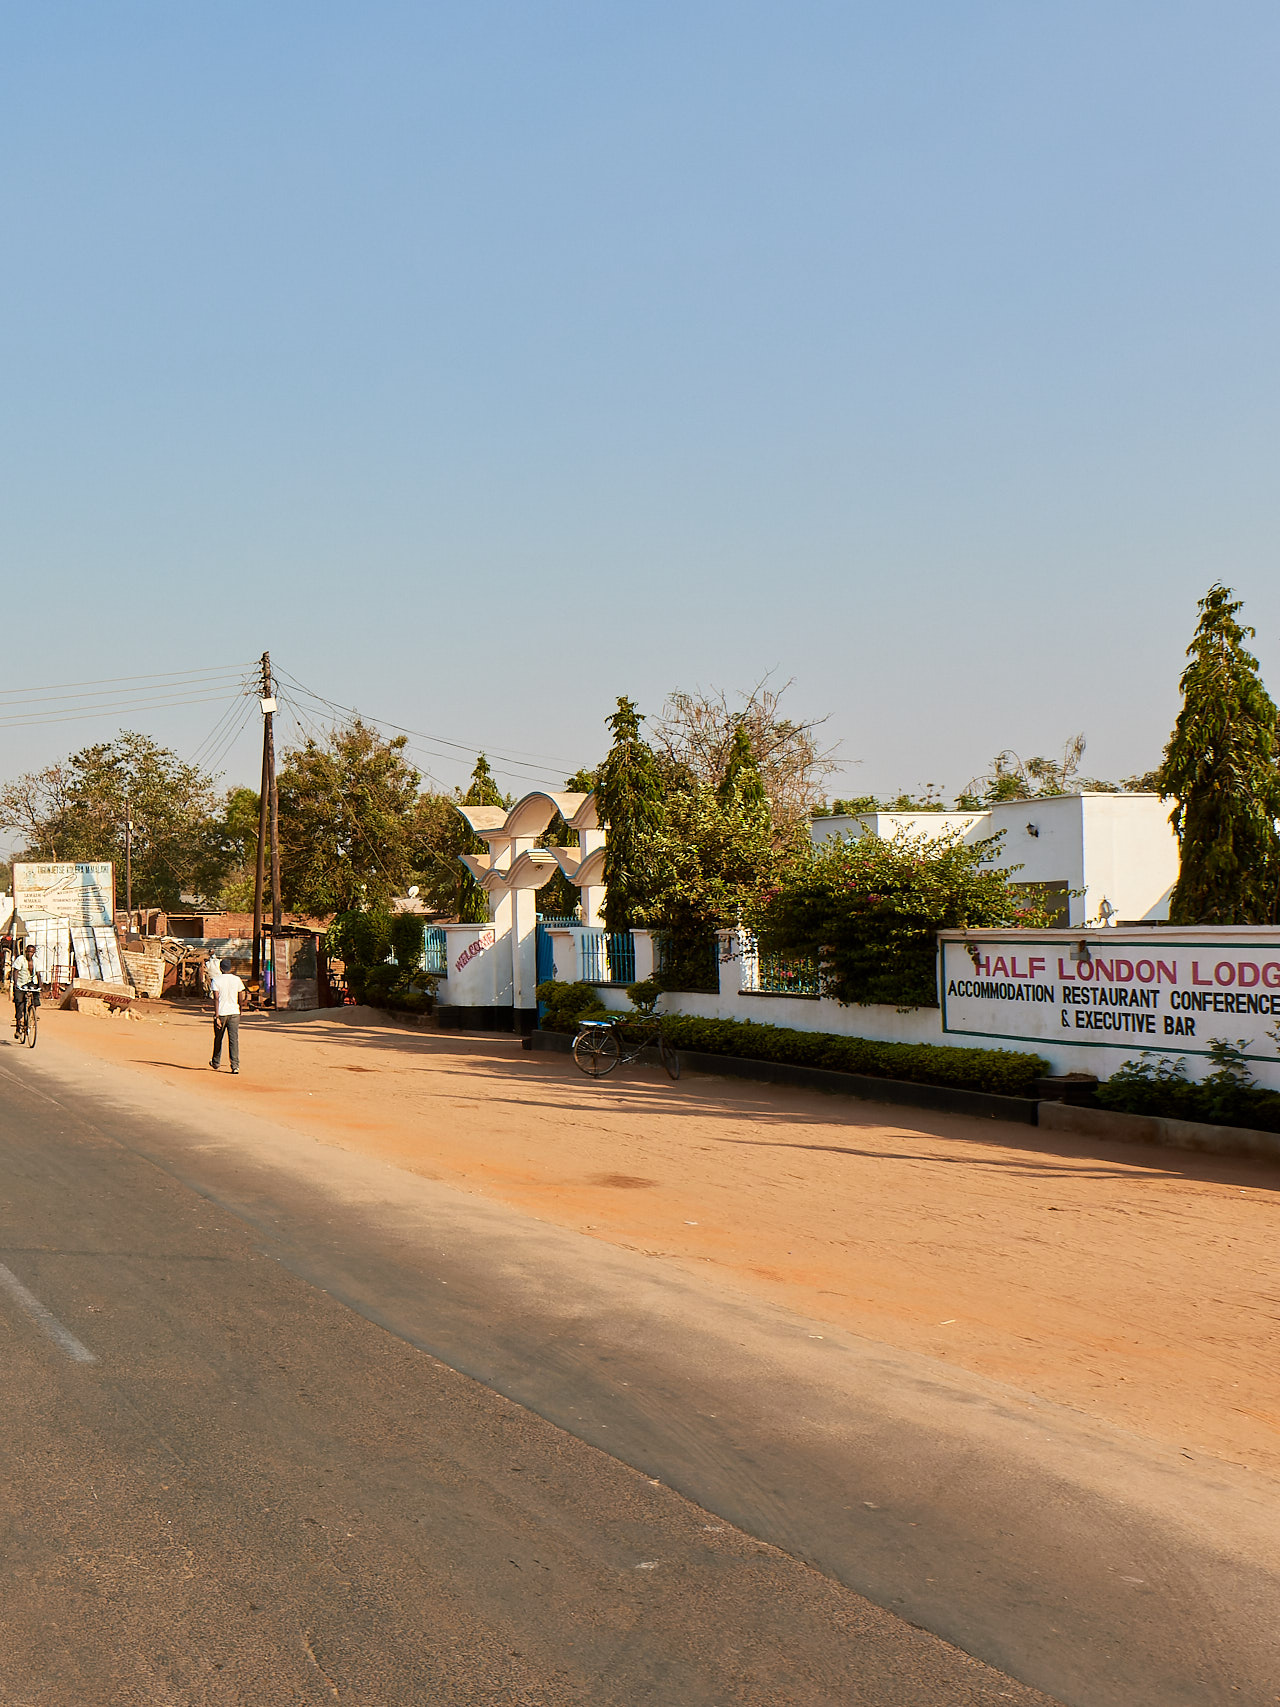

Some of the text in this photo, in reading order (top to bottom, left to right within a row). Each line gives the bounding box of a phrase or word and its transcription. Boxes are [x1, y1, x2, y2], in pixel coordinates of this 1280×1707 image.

[455, 932, 492, 972] WELCOME
[974, 956, 1046, 979] HALF
[1058, 958, 1178, 985] LONDON
[98, 994, 131, 1004] LONDON
[948, 980, 1280, 1015] ACCOMMODATION RESTAURANT CONFERENCE
[1061, 1009, 1197, 1036] & EXECUTIVE BAR
